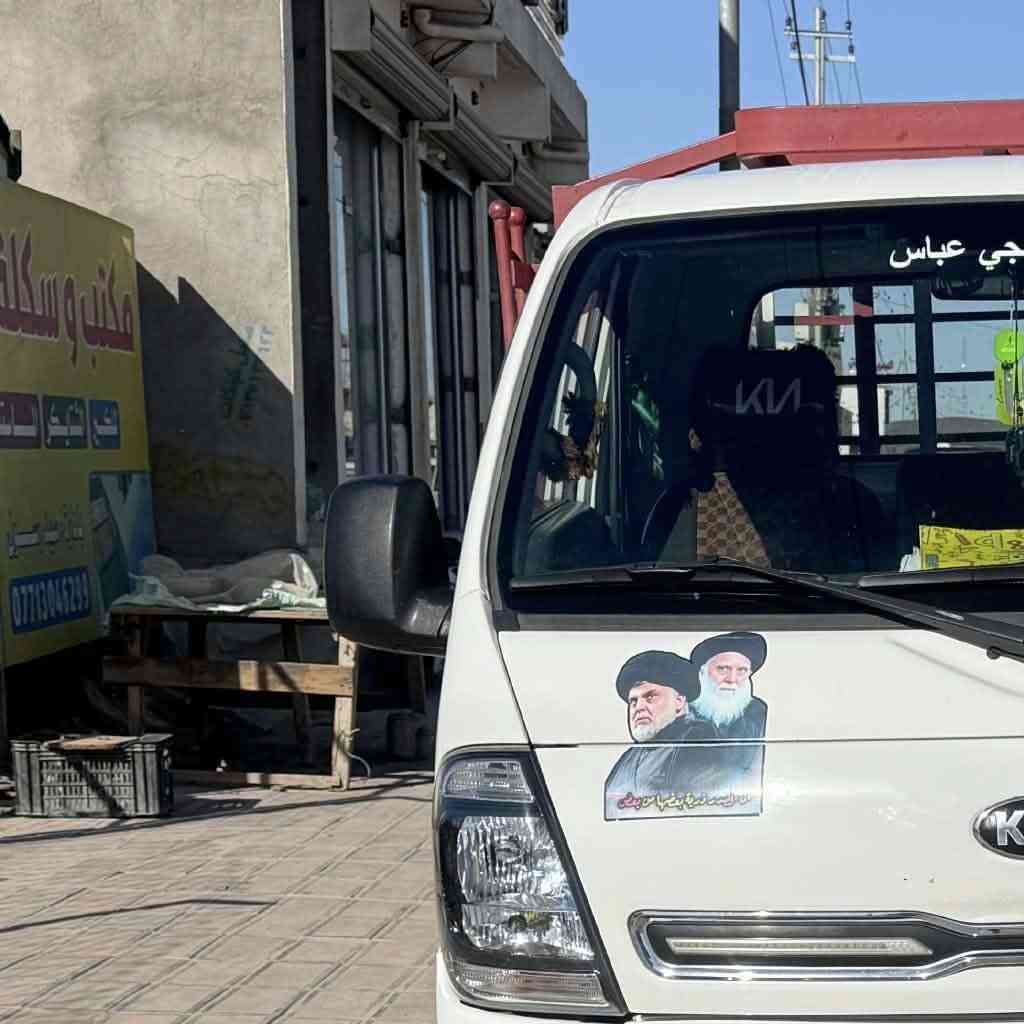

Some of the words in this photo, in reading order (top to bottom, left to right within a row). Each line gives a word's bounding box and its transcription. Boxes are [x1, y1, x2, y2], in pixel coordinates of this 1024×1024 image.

[889, 235, 966, 269] عباس
[79, 257, 134, 369] مكتب
[736, 377, 801, 415] KIA
